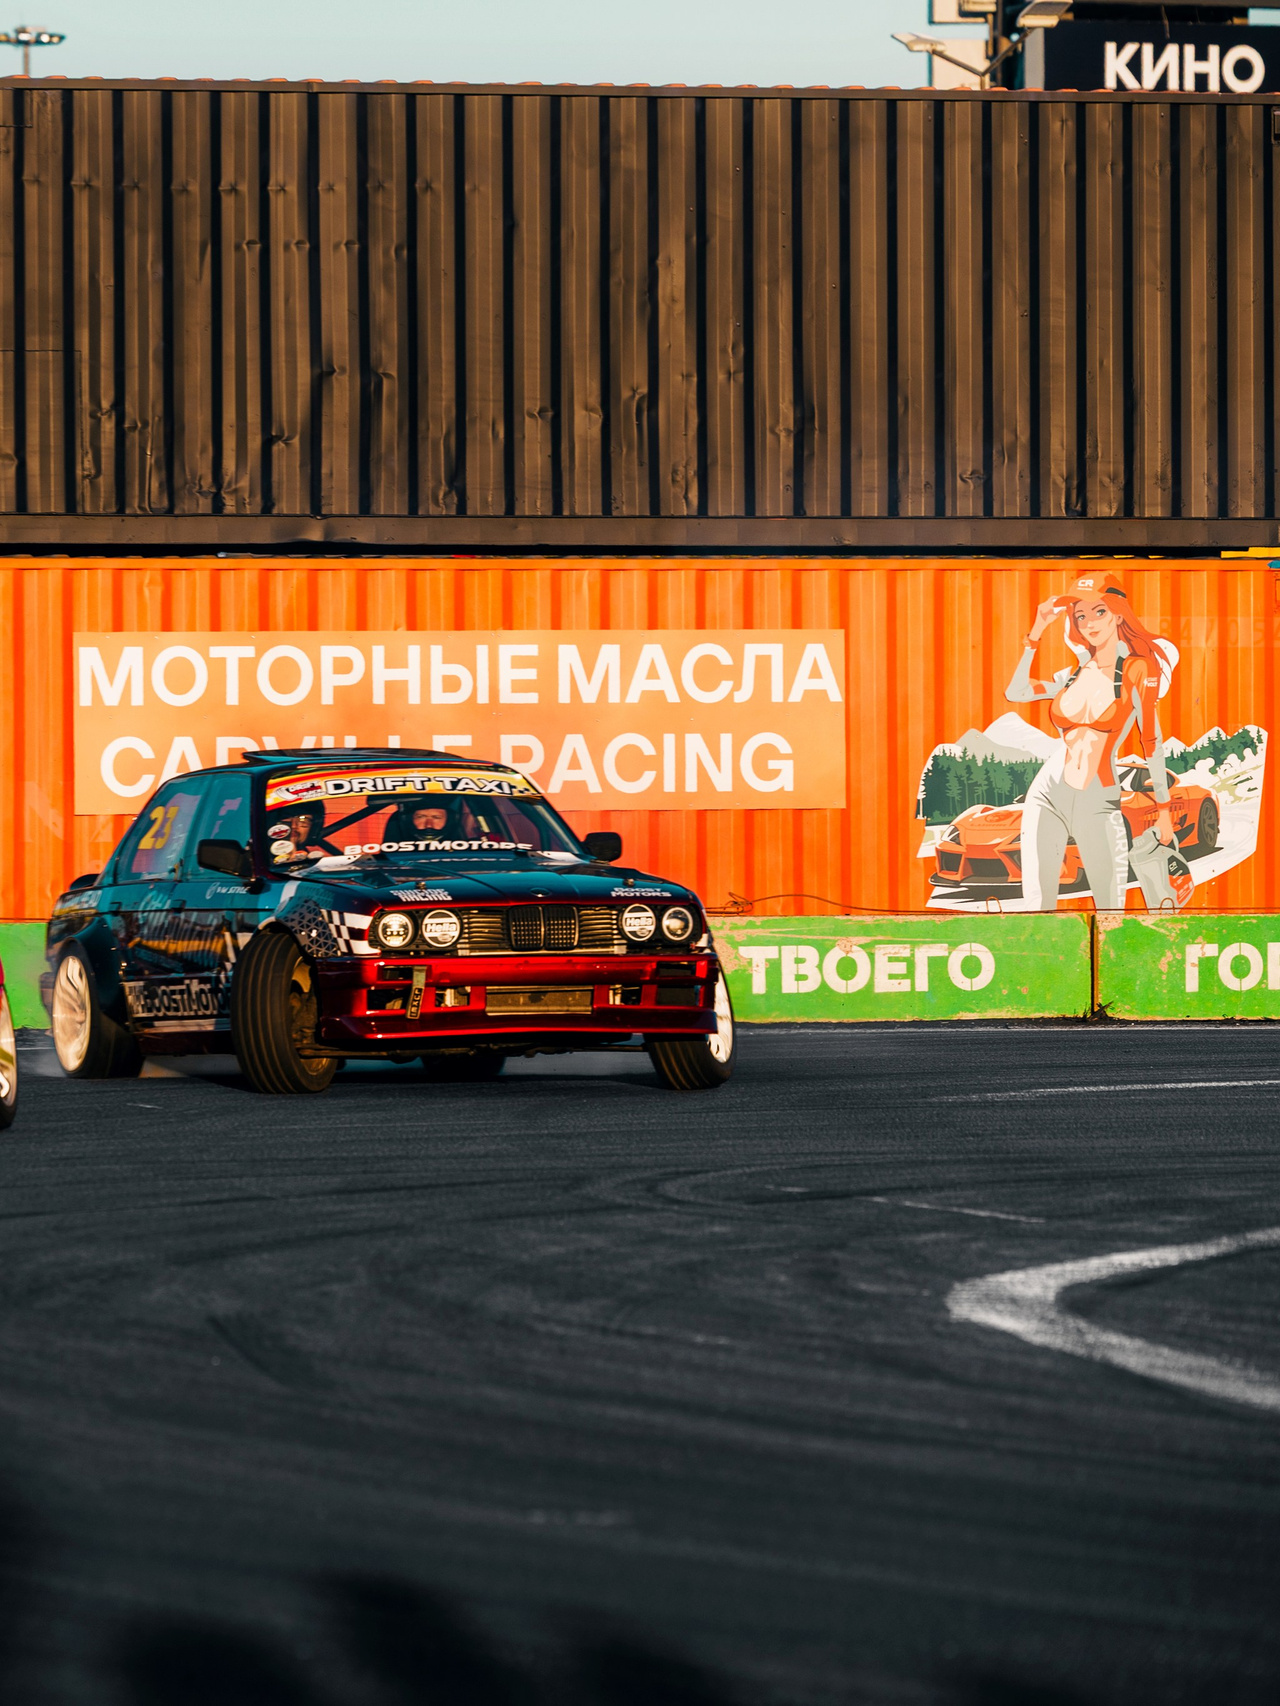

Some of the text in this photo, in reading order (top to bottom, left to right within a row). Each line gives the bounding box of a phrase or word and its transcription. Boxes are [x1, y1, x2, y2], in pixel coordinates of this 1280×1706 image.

[1104, 41, 1266, 93] КИНО
[79, 643, 843, 707] МОТОРНЫЕ МАСЛА
[325, 777, 432, 796] DRIFT
[435, 777, 513, 796] TAXI
[501, 732, 794, 794] RACING
[138, 806, 179, 849] 23
[1109, 810, 1129, 907] CARVILLE
[425, 922, 458, 933] Hella
[624, 917, 653, 927] Hella
[738, 942, 995, 994] ТВОЕГО
